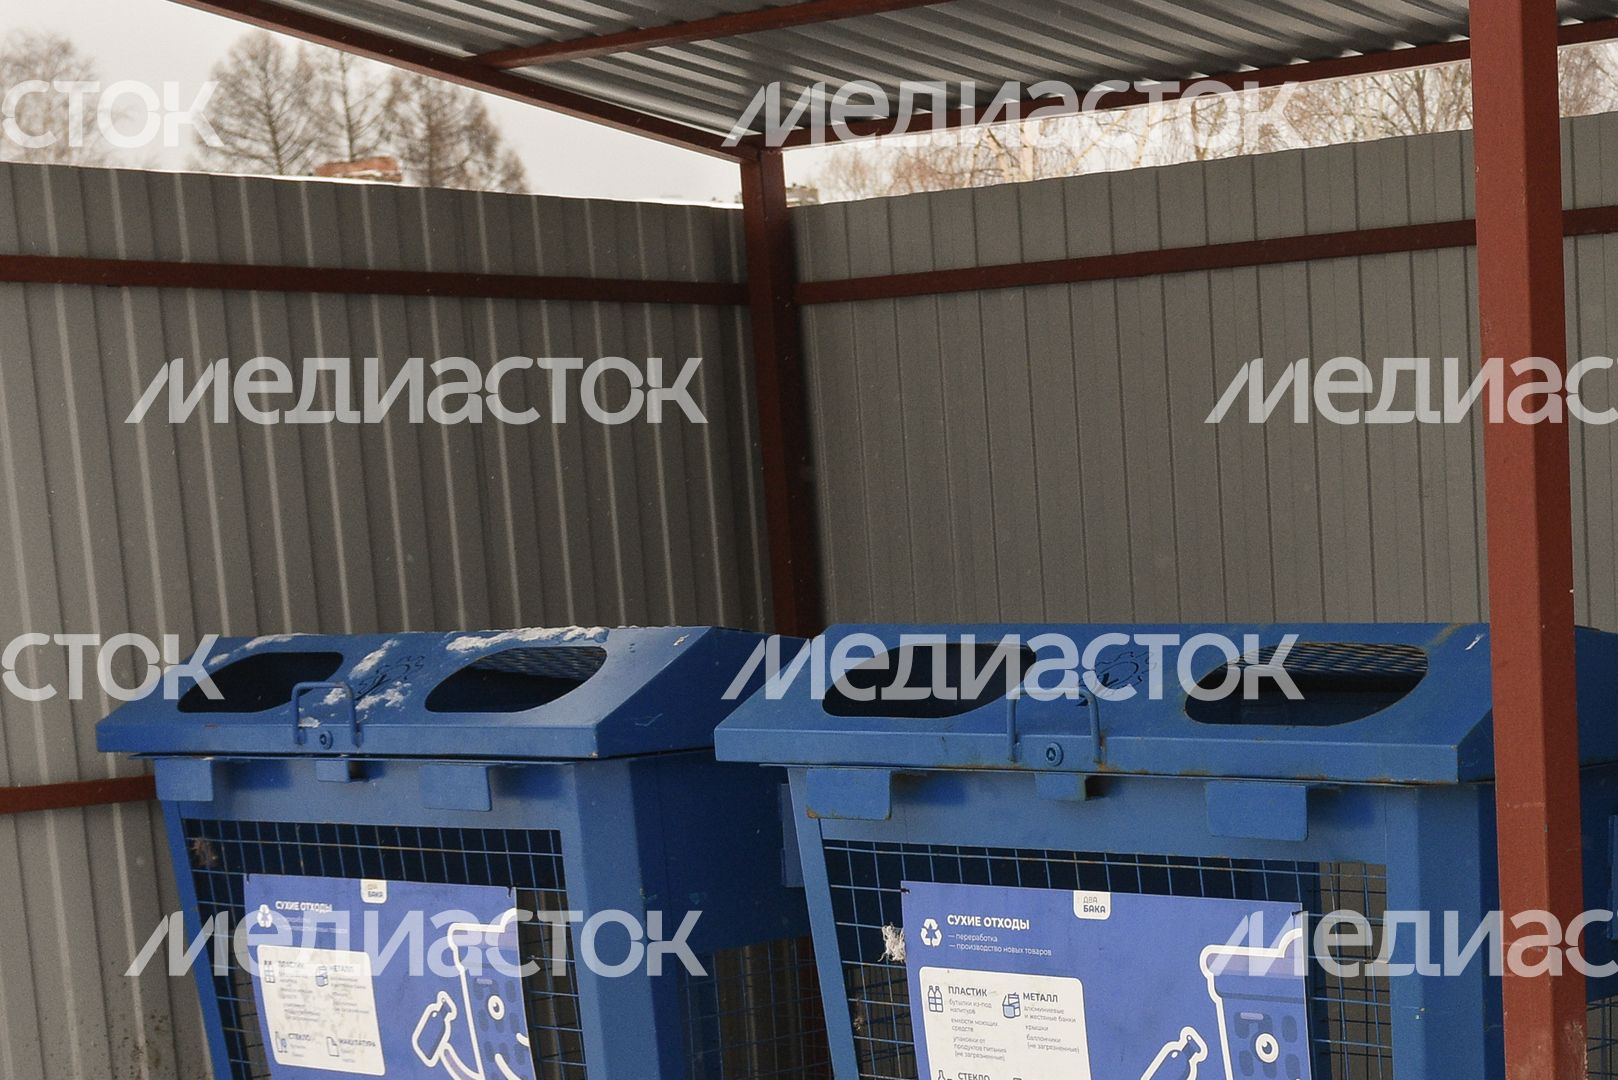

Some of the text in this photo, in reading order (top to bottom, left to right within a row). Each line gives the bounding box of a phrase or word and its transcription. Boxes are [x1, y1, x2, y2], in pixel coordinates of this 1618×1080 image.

[1083, 905, 1106, 914] БАКА
[947, 914, 1030, 931] СУХИЕ ОТХОДЫ
[955, 933, 998, 943] переработка
[956, 942, 1002, 953] производство
[1003, 946, 1024, 954] новых
[1025, 948, 1052, 957] товаров
[948, 986, 987, 997] ПЛАСТИК
[1023, 992, 1058, 1003] МЕТАЛЛ
